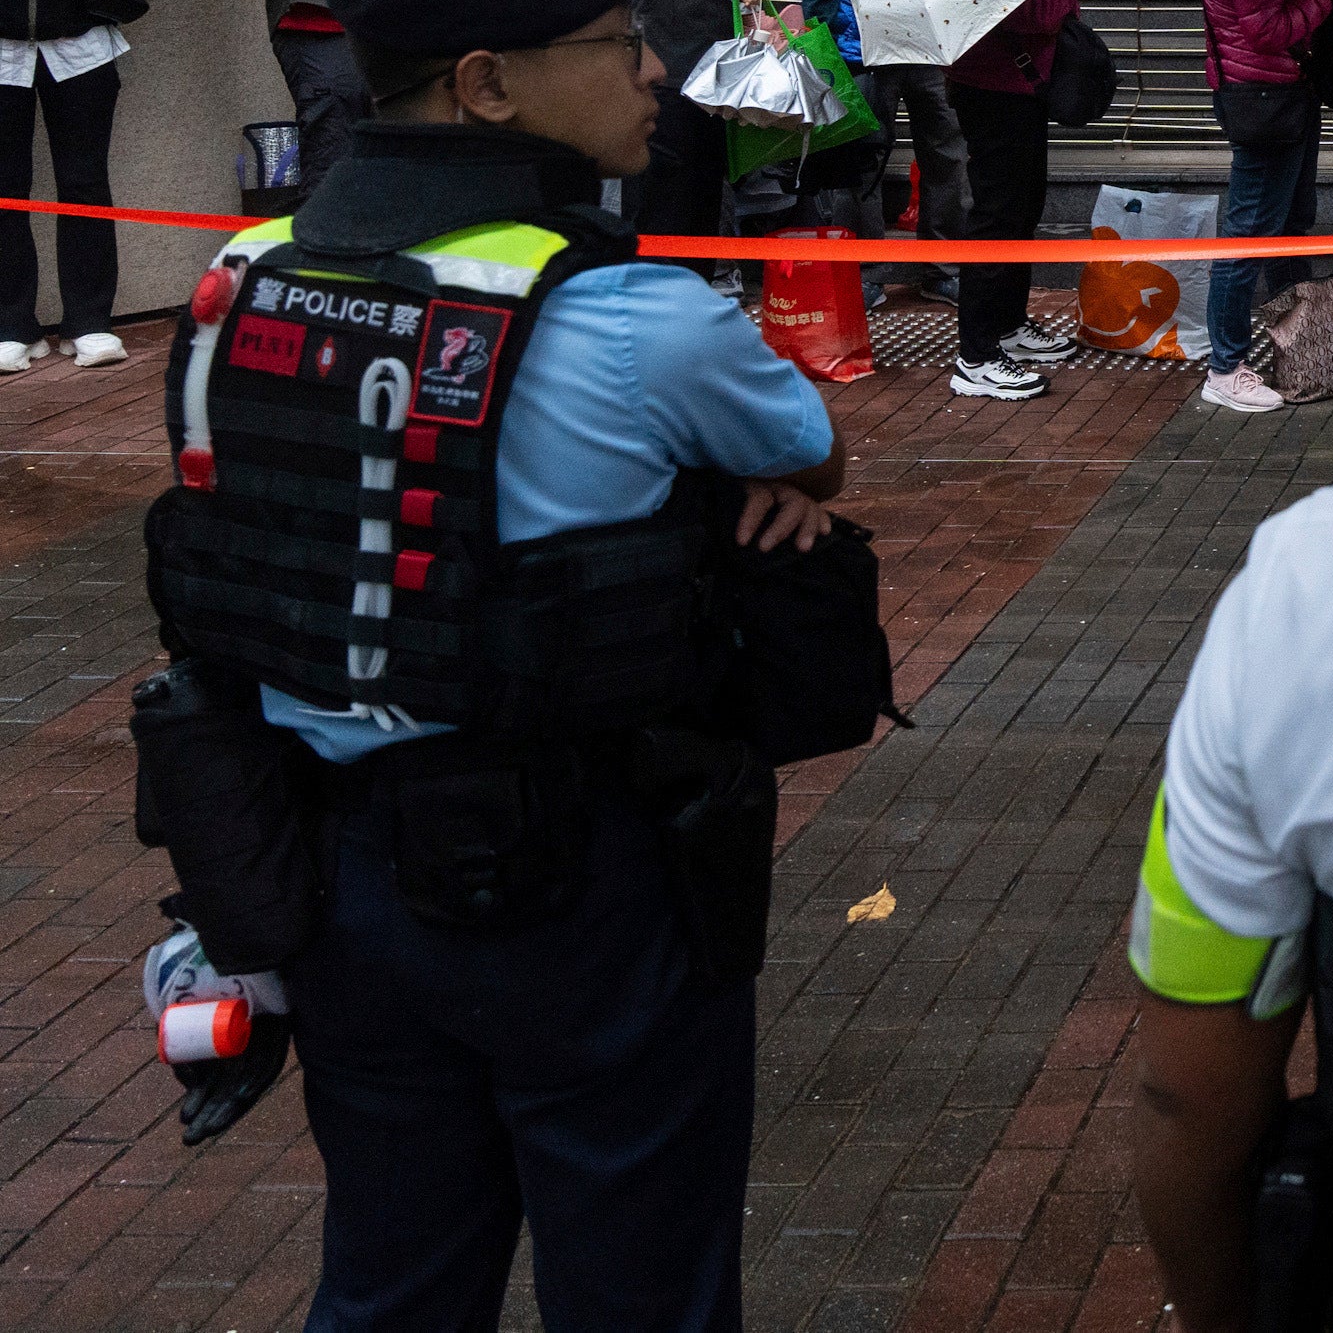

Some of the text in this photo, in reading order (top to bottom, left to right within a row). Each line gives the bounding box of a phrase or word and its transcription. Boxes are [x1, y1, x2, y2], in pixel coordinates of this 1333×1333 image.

[252, 276, 424, 337] 警 POLICE 察
